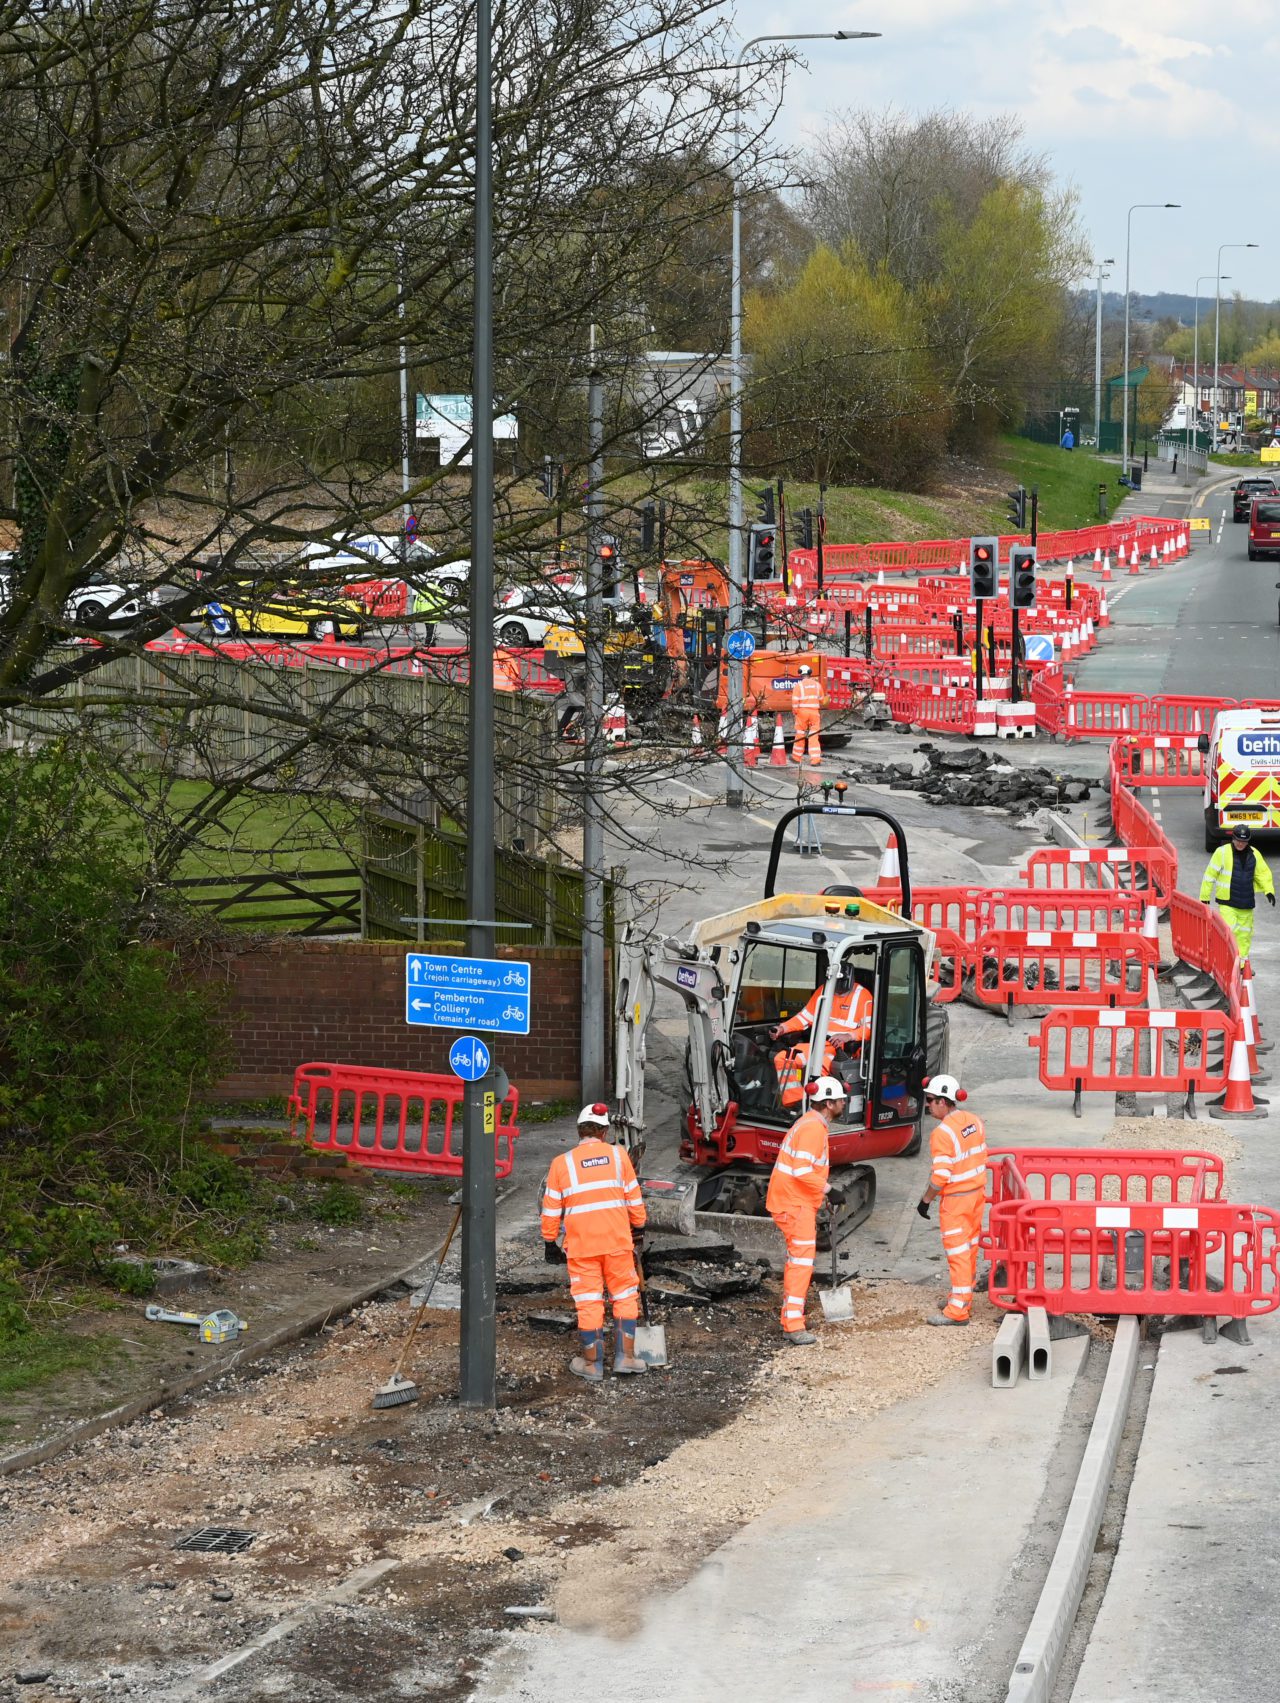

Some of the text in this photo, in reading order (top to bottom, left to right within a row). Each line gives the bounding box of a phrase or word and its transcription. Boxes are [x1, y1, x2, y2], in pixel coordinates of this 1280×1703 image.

[773, 680, 801, 689] bethe
[424, 961, 483, 975] Town Centre
[423, 971, 501, 987] (rejoin carriageway)
[434, 991, 485, 1005] Pemberton
[433, 1003, 471, 1016] Colliery
[433, 1012, 500, 1028] (remain off road)
[582, 1157, 609, 1168] bethell
